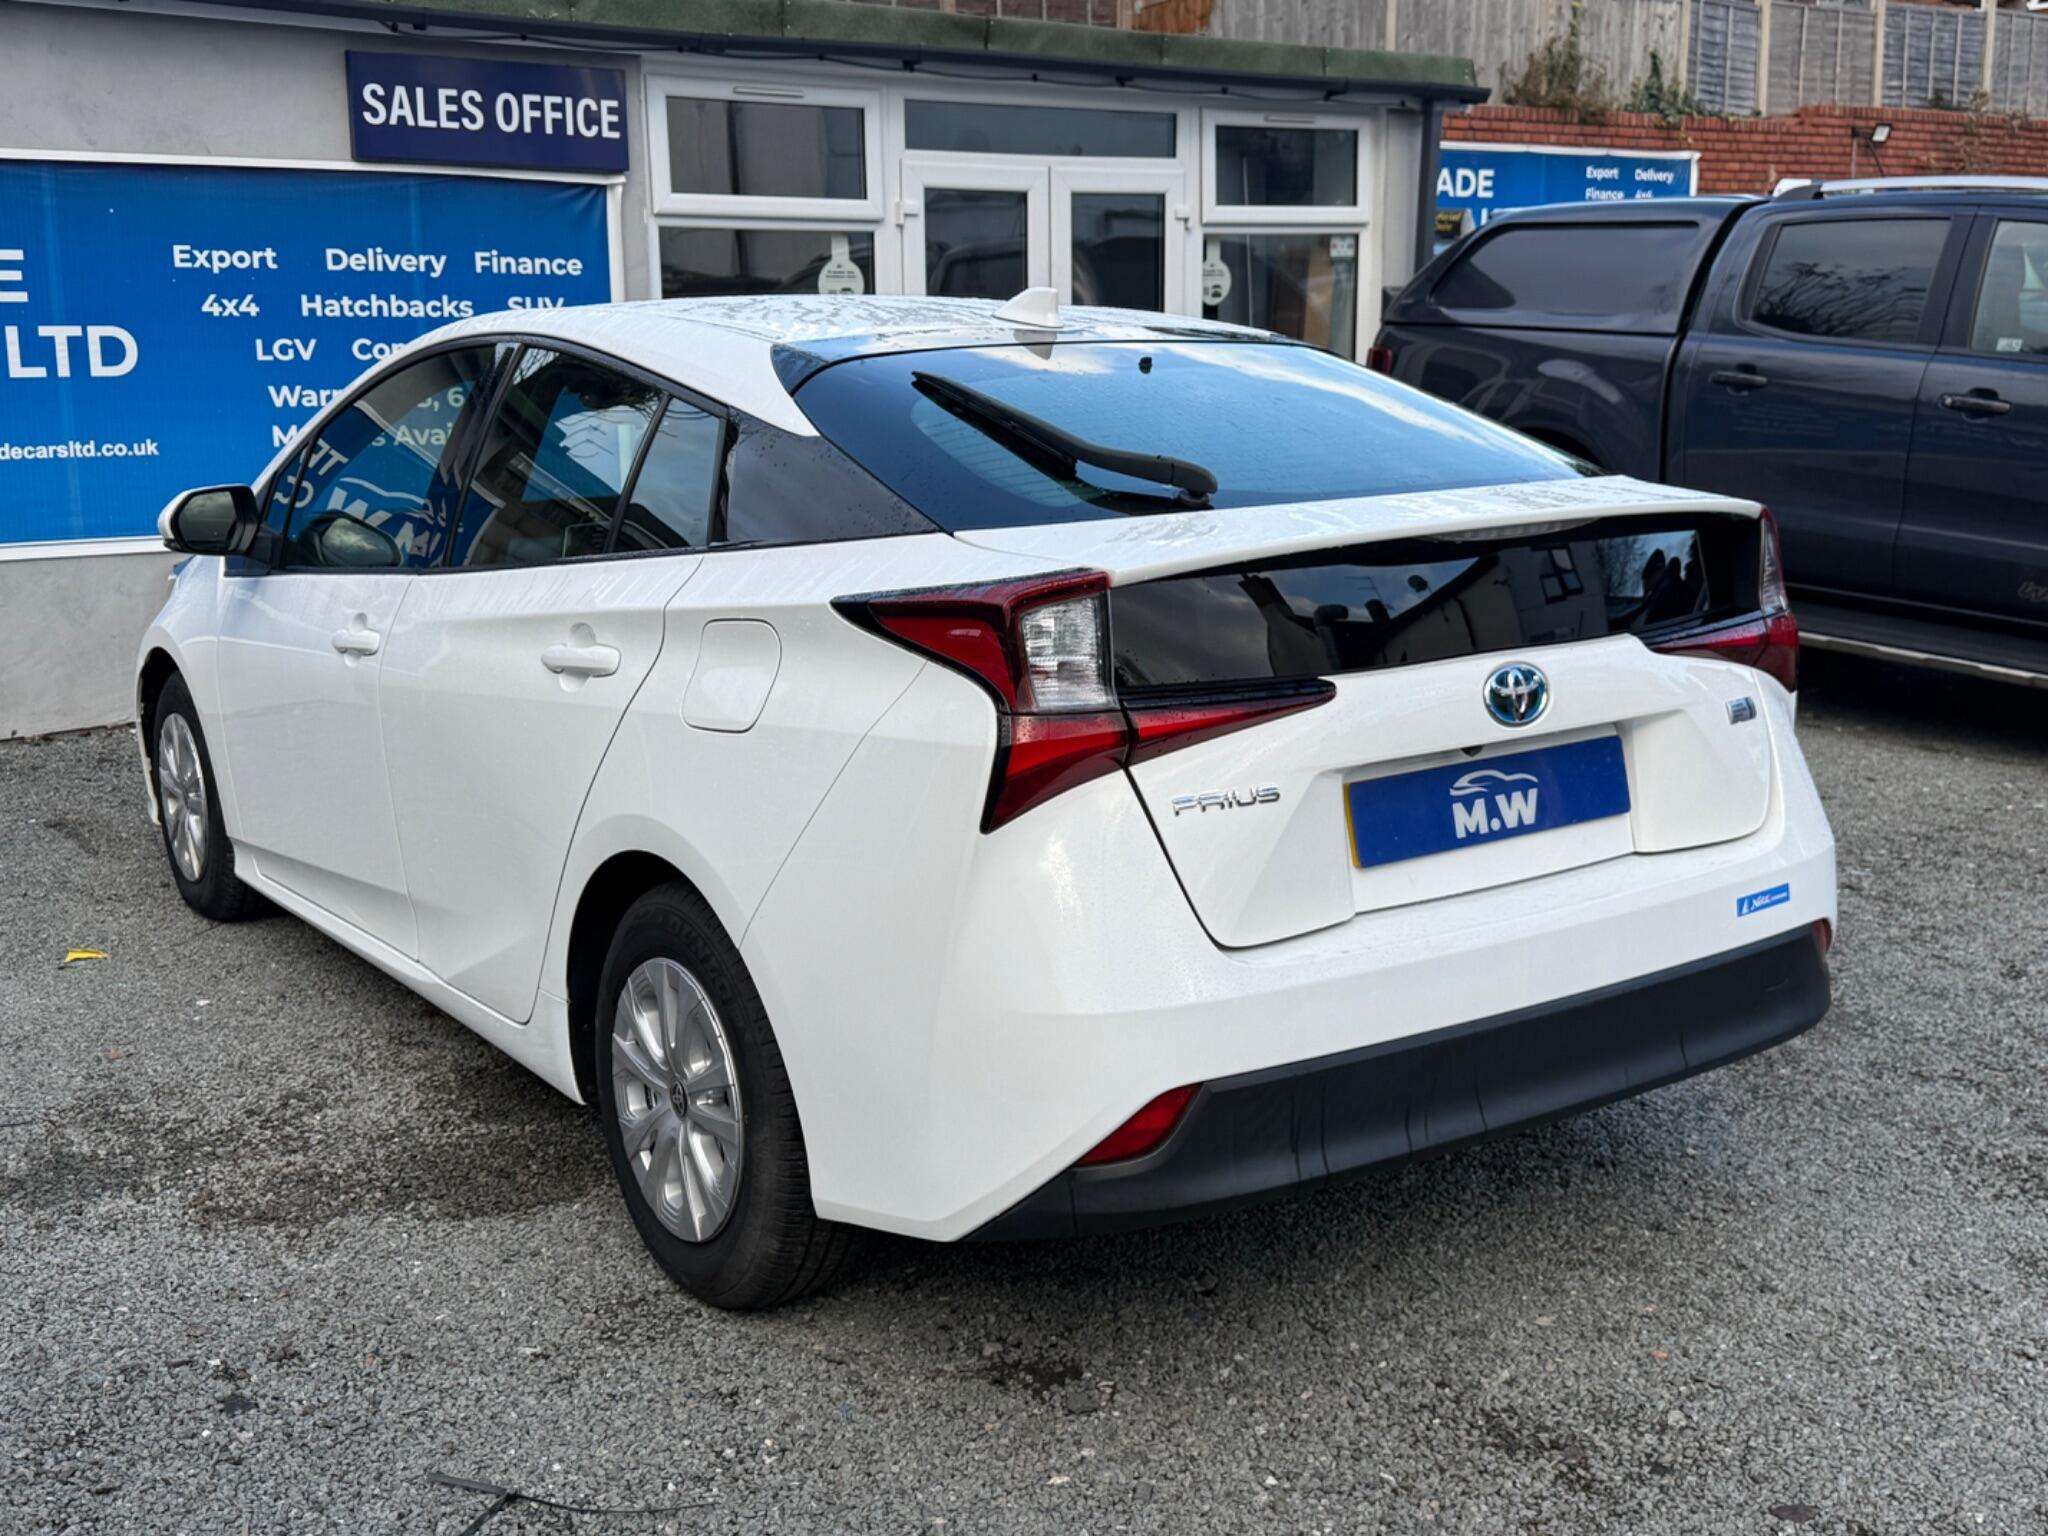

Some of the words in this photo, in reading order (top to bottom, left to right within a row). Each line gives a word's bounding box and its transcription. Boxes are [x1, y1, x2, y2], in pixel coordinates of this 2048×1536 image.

[362, 83, 484, 131] SALES
[495, 93, 621, 139] OFFICE
[1436, 167, 1495, 198] ADE
[1586, 166, 1619, 181] Export
[1634, 168, 1674, 185] Delivery
[1585, 187, 1624, 200] Finance
[173, 245, 279, 274] Export
[325, 247, 447, 278] Delivery
[474, 250, 583, 276] Finance
[201, 294, 260, 317] 4x4
[300, 295, 474, 318] Hatchbacks
[5, 325, 139, 378] LTD
[255, 338, 317, 361] LGV
[1172, 786, 1281, 816] PRIUS
[1452, 787, 1538, 839] M.W
